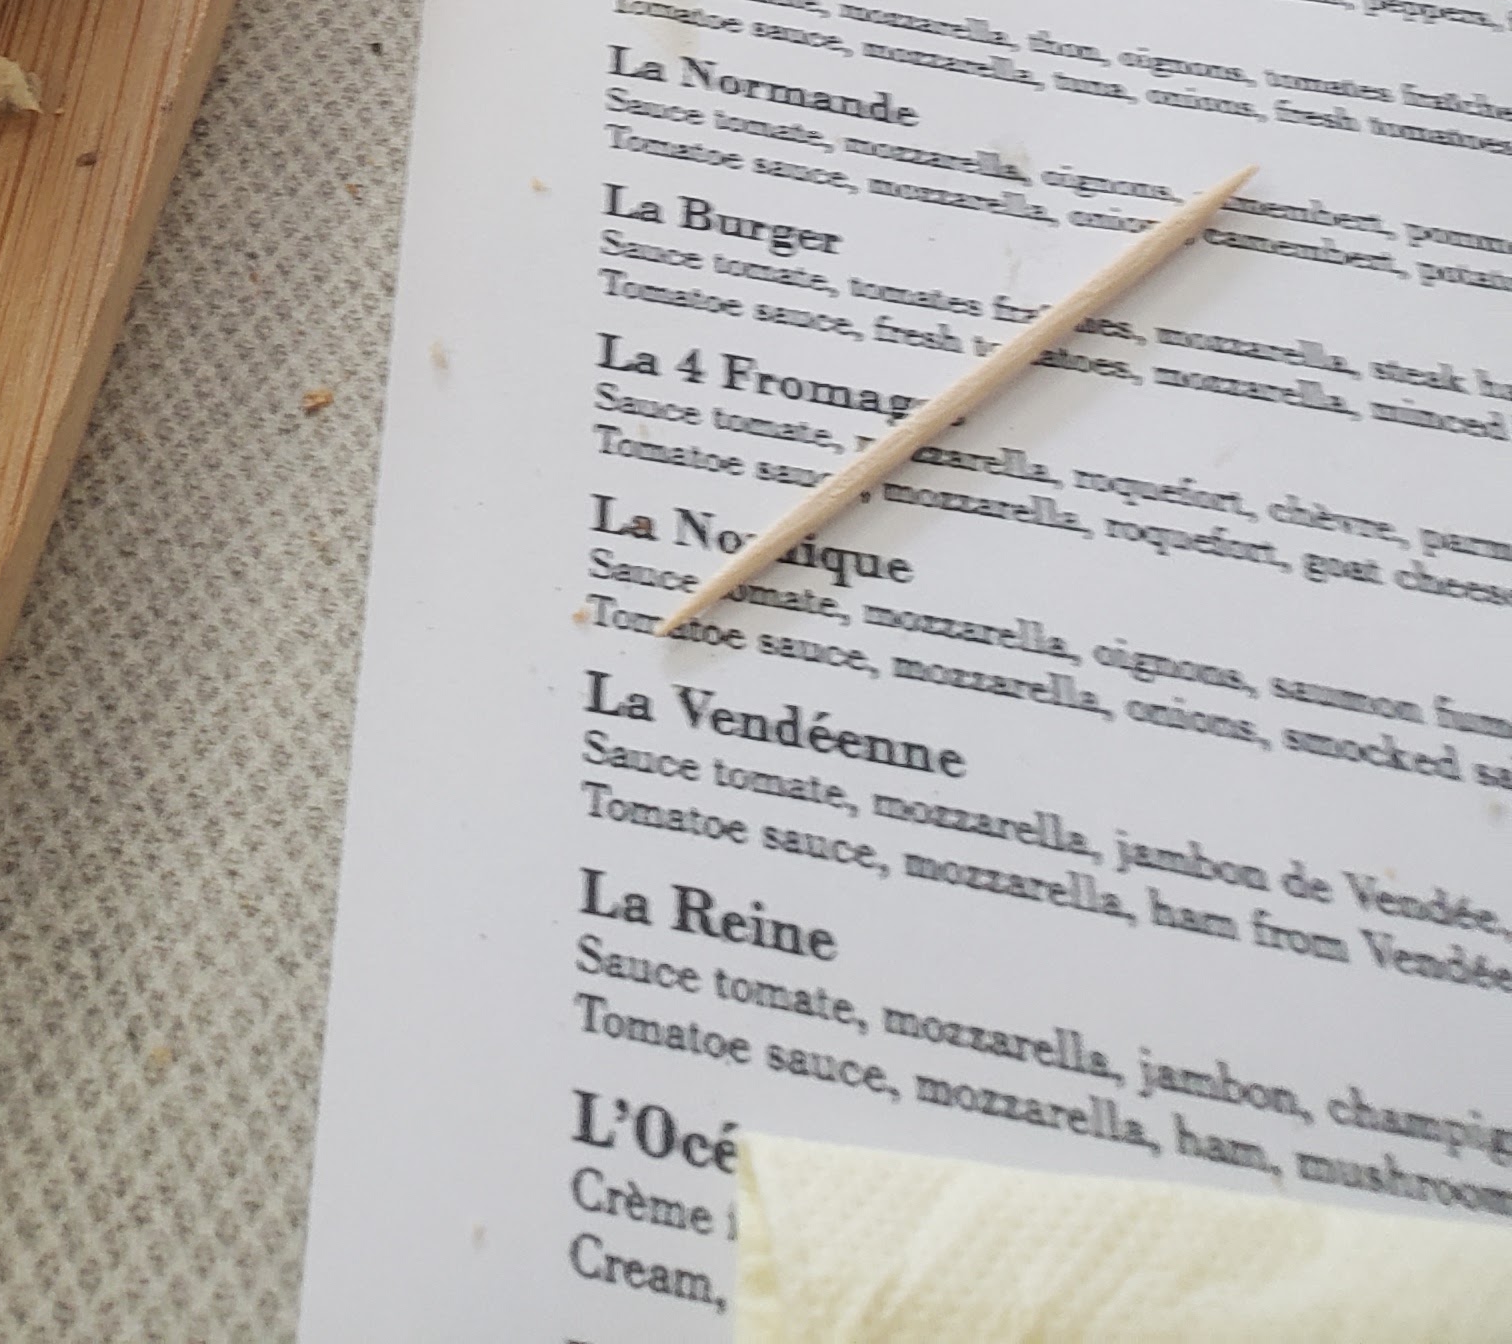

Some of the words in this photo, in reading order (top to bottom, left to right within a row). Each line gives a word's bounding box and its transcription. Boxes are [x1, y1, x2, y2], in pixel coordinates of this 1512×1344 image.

[605, 86, 706, 126] Sauce
[713, 109, 836, 155] tomate,
[606, 44, 669, 83] La
[679, 55, 922, 128] Normande
[751, 21, 855, 59] sauce,
[1368, 115, 1512, 157] tomatoe
[602, 182, 666, 225] La
[677, 194, 846, 259] Burger
[605, 123, 745, 170] Tomatoe
[752, 157, 860, 195] sauce,
[1067, 206, 1196, 246] onio,
[598, 267, 745, 317] Tomatoe
[751, 299, 865, 343] sauce,
[872, 314, 967, 355] fresh
[600, 228, 705, 271] Sauce
[712, 253, 840, 298] tomate,
[593, 381, 704, 426] Sauce
[712, 405, 846, 455] tomate,
[595, 331, 663, 377] La
[673, 347, 708, 385] 4
[719, 350, 967, 428] Fromag
[592, 423, 746, 476] Tomatoe
[755, 459, 872, 505] sauc,
[882, 482, 1094, 541] mozzarella,
[590, 492, 660, 542] La
[673, 506, 916, 590] Noique
[588, 546, 700, 594] Sauce
[720, 580, 852, 628] omate,
[862, 602, 1084, 667] mozzarella,
[1432, 693, 1512, 740] fum
[757, 632, 881, 680] sauce,
[891, 655, 1116, 723] mozzarella,
[582, 668, 655, 723] La
[670, 682, 969, 780] Vendéenne
[581, 729, 701, 783] Sauce
[712, 757, 860, 818] tomate,
[871, 792, 1105, 867] mozzarella,
[1114, 829, 1272, 894] jambon
[1280, 858, 1334, 905] de
[577, 866, 655, 927] La
[669, 883, 841, 963] Reine
[580, 779, 751, 846] Tomatoe
[760, 823, 891, 880] sauce,
[903, 851, 1139, 929] mozzarella,
[1145, 884, 1241, 942] ham
[1250, 907, 1351, 965] from
[574, 932, 702, 995] Sauce
[713, 966, 870, 1036] tomate,
[881, 1006, 1127, 1088] mozzarella,
[1138, 1044, 1316, 1127] jambon,
[1326, 1083, 1512, 1169] champig
[570, 1087, 741, 1176] L'Océ
[572, 991, 753, 1065] Tomatoe
[765, 1041, 903, 1102] sauce,
[913, 1072, 1164, 1159] mozzarella,
[1172, 1111, 1285, 1178] ham,
[1294, 1149, 1512, 1218] mushroom
[569, 1166, 717, 1236] Crème
[566, 1231, 729, 1316] Cream,
